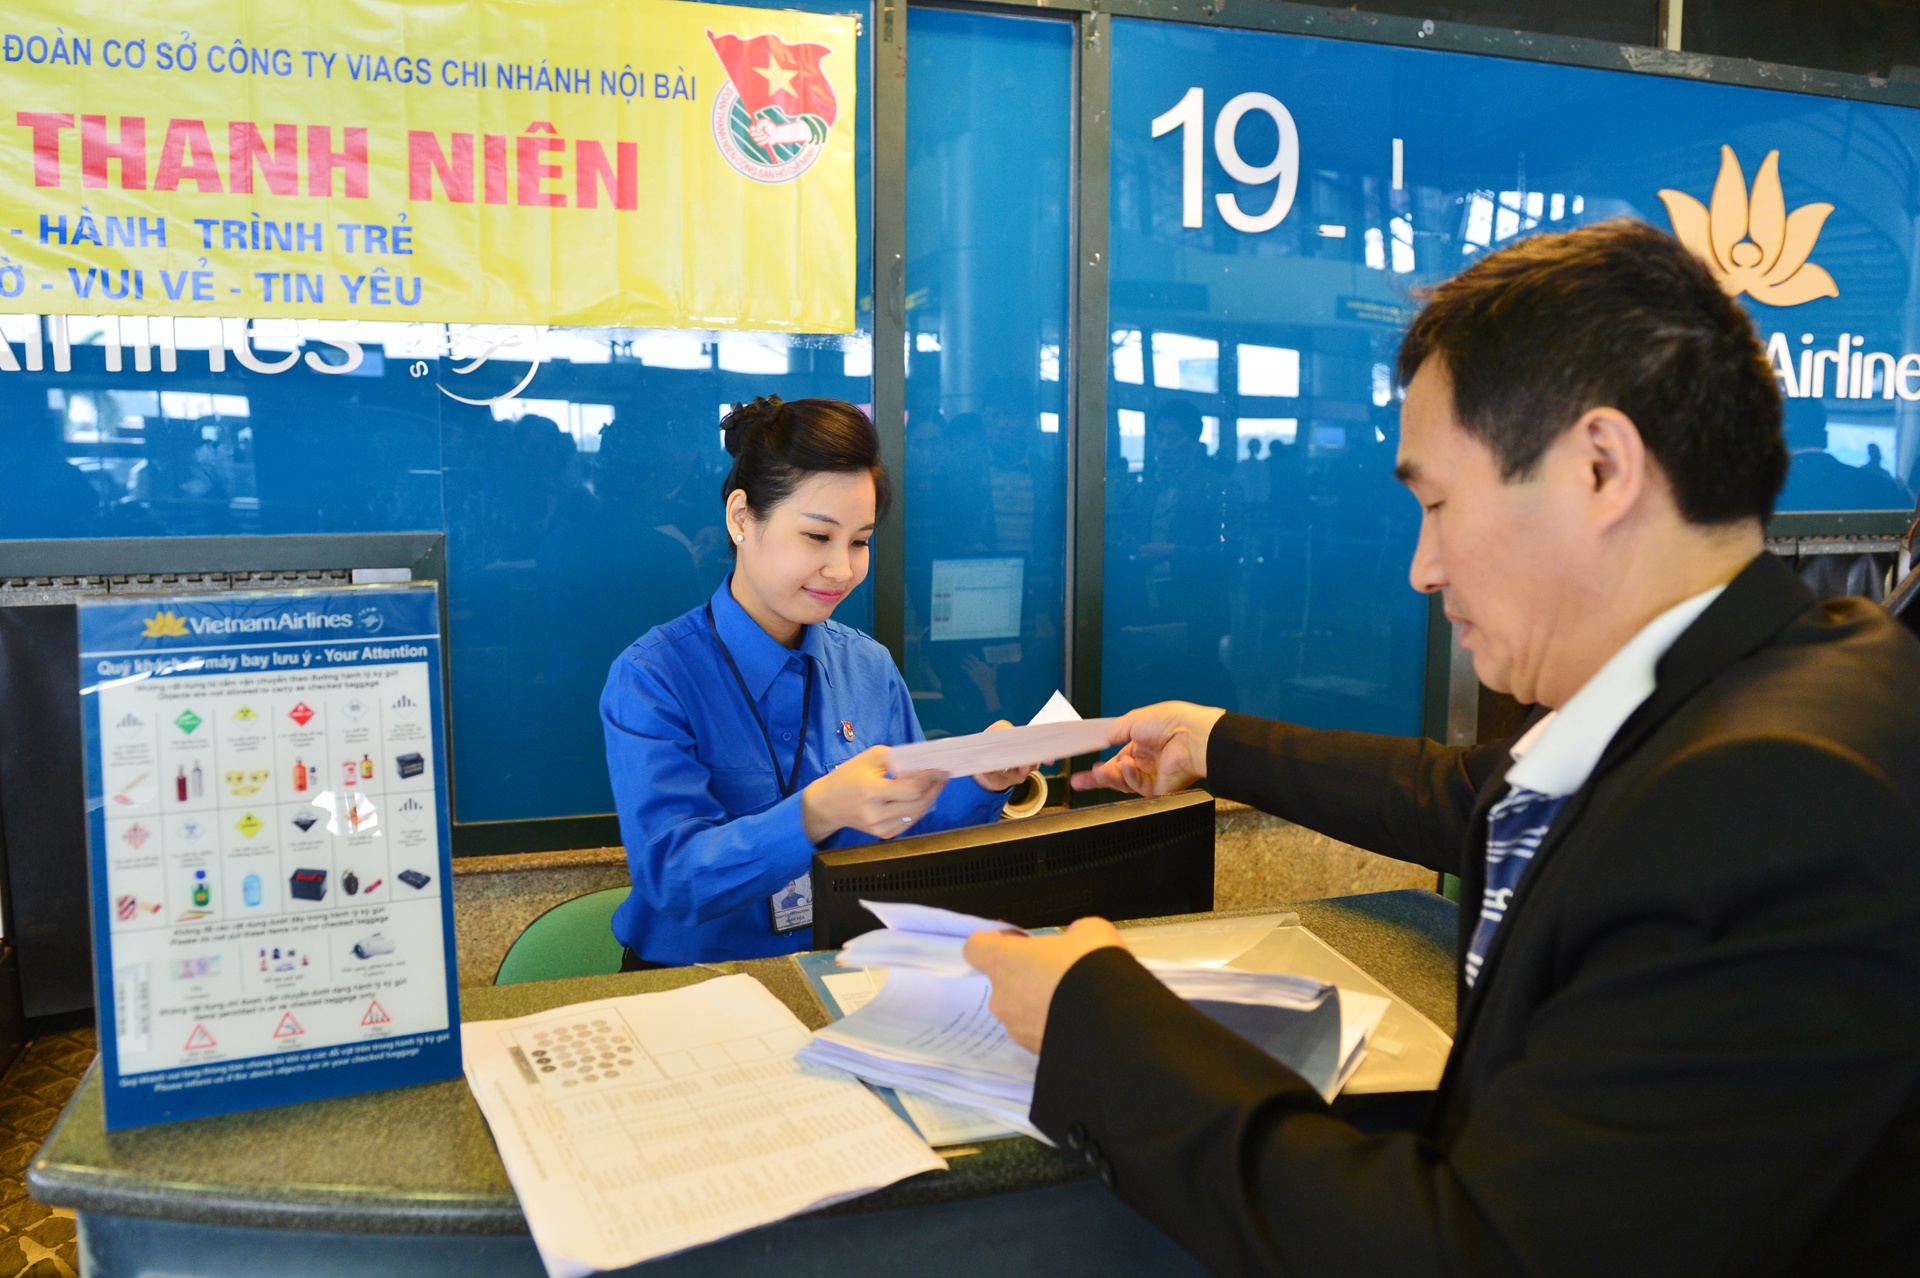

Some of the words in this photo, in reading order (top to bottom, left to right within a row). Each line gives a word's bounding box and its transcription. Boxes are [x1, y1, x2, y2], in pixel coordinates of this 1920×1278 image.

[3, 27, 91, 66] ĐOÀN
[102, 39, 146, 69] CƠ
[156, 31, 197, 71] SỞ
[207, 39, 292, 77] CÔNG
[302, 51, 337, 79] TY
[346, 53, 432, 85] VIAGS
[441, 60, 487, 88] CHI
[497, 58, 590, 94] NHÁNH
[601, 64, 644, 104] NỘI
[655, 66, 697, 101] BÀI
[16, 111, 370, 199] THANH
[408, 121, 638, 211] NIÊN
[1151, 87, 1300, 233] 19
[39, 207, 167, 248] HÀNH
[193, 211, 324, 253] TRÌNH
[337, 212, 414, 257] TRẺ
[68, 267, 143, 300] VUI
[160, 257, 216, 301] VẺ
[254, 272, 324, 304] TIN
[338, 267, 423, 306] YÊU
[190, 617, 277, 634] Vietnam
[278, 612, 352, 630] Airlines
[205, 656, 238, 671] máy
[241, 653, 270, 669] bay
[273, 652, 298, 665] lưu
[325, 648, 358, 662] Your
[361, 644, 428, 661] Attention
[272, 685, 293, 694] carry
[308, 682, 342, 692] checked
[344, 680, 379, 690] baggage
[351, 1052, 384, 1064] checked
[386, 1047, 420, 1060] baggage
